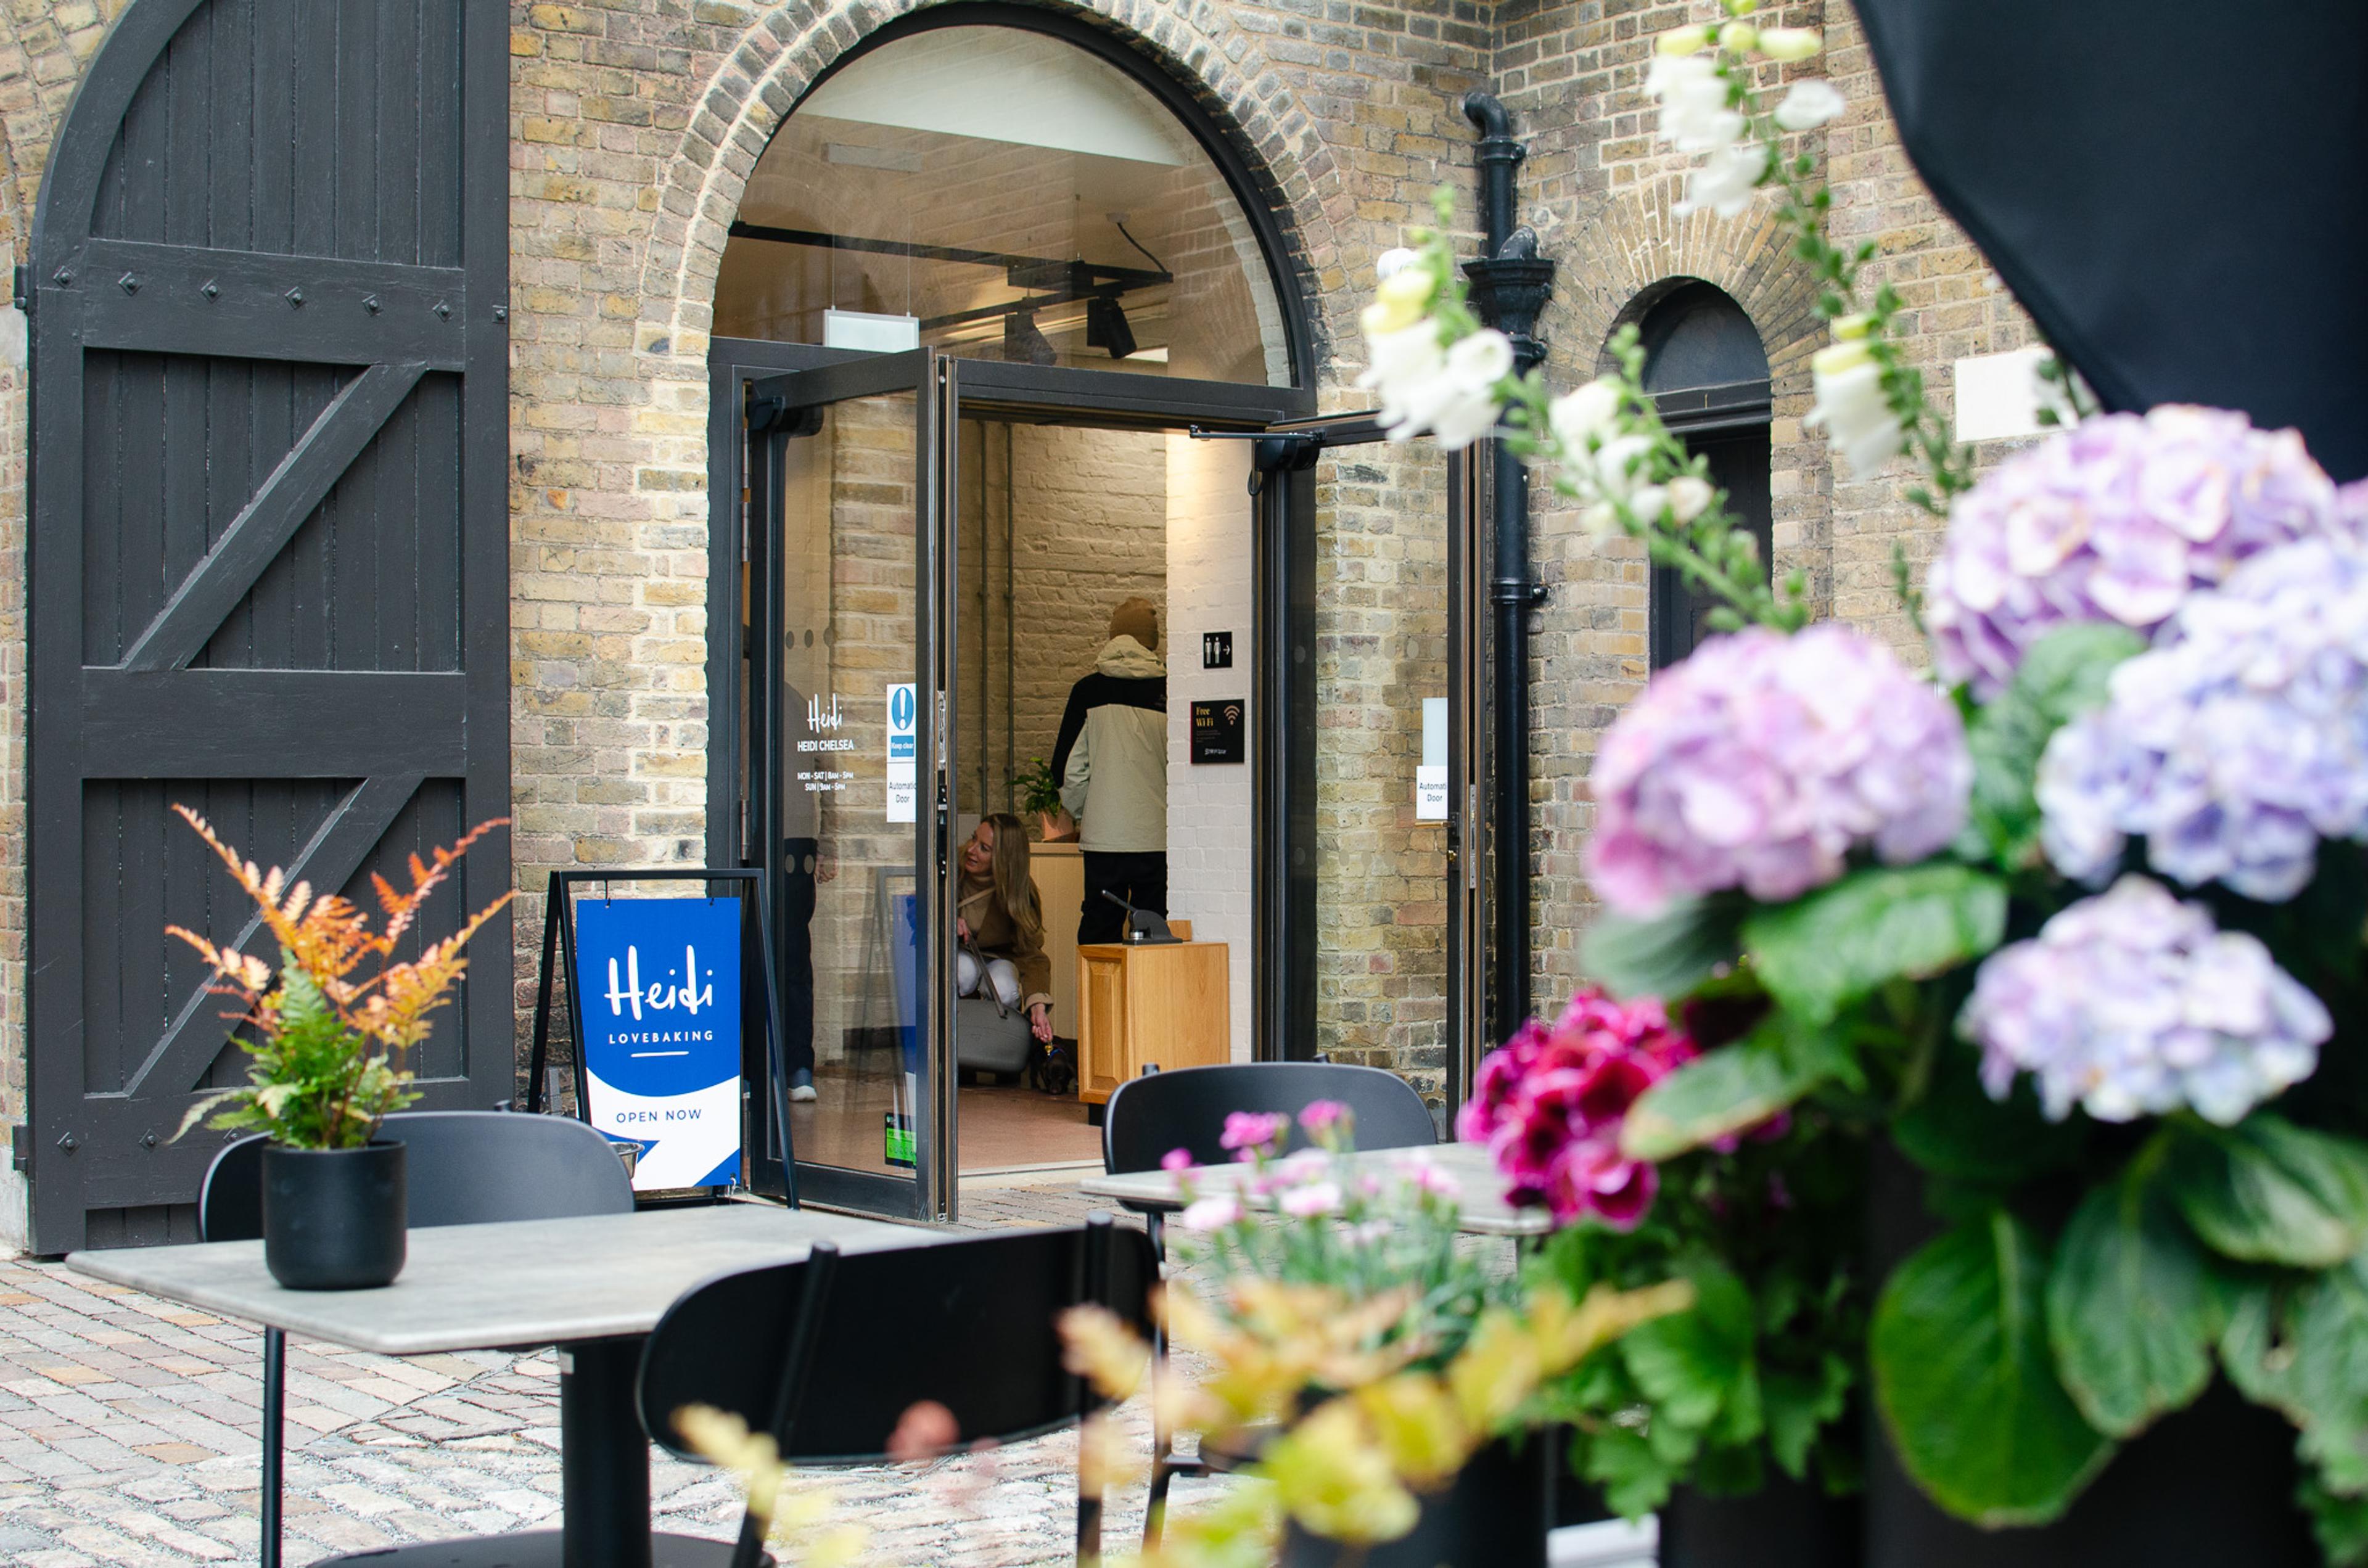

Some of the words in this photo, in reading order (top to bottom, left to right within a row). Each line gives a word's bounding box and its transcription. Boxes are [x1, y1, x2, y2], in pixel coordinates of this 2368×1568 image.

[807, 692, 842, 734] Heidi
[1196, 707, 1211, 716] Free
[797, 741, 818, 752] HEIDI
[819, 739, 855, 751] CHELSEA
[797, 772, 811, 780] MON
[814, 771, 824, 780] SAT
[805, 782, 816, 792] SUN
[1419, 782, 1447, 790] Automati
[895, 794, 910, 803] Door
[1428, 794, 1443, 802] Door
[604, 945, 713, 1021] Heidi
[609, 1030, 713, 1045] LOVEBAKING
[616, 1111, 658, 1123] OPEN
[665, 1109, 702, 1121] NOW
